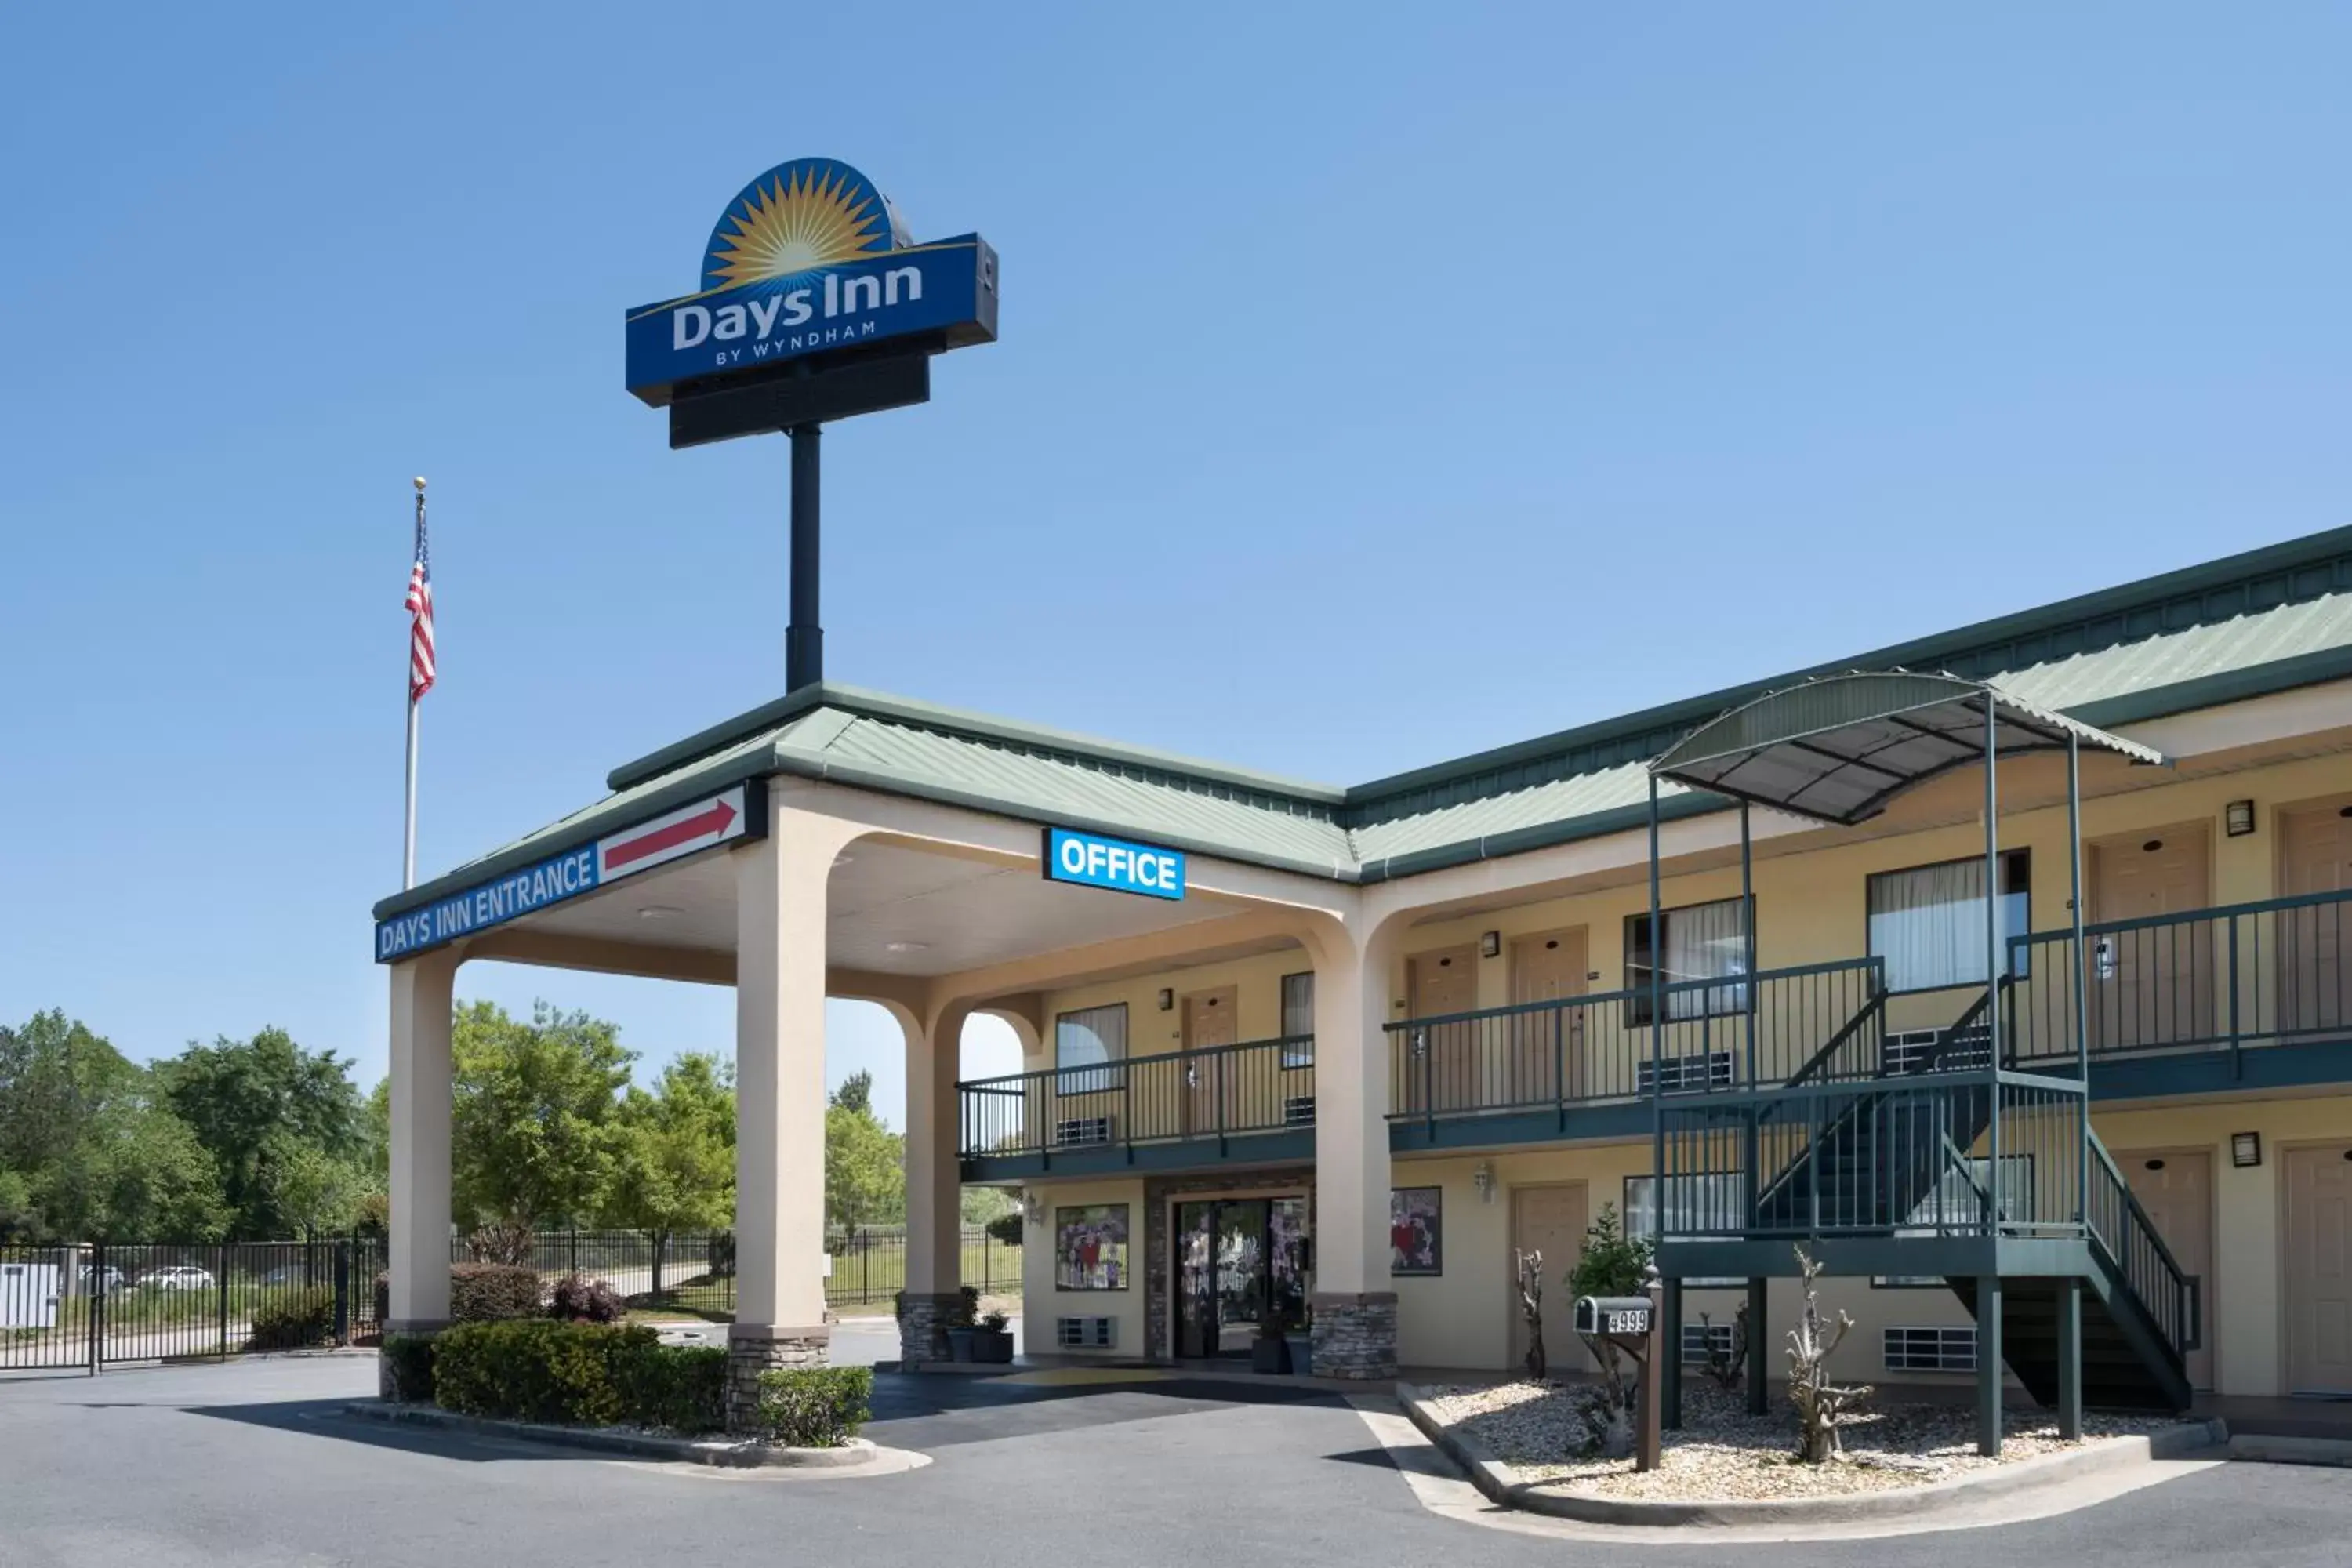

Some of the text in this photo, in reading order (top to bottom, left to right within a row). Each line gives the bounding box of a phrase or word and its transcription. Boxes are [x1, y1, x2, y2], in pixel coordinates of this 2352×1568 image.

[673, 265, 922, 350] Days Inn
[717, 321, 875, 365] BY WYNDHAM
[1062, 839, 1176, 890] OFFICE
[381, 851, 590, 955] DAYS INN ENTRANCE
